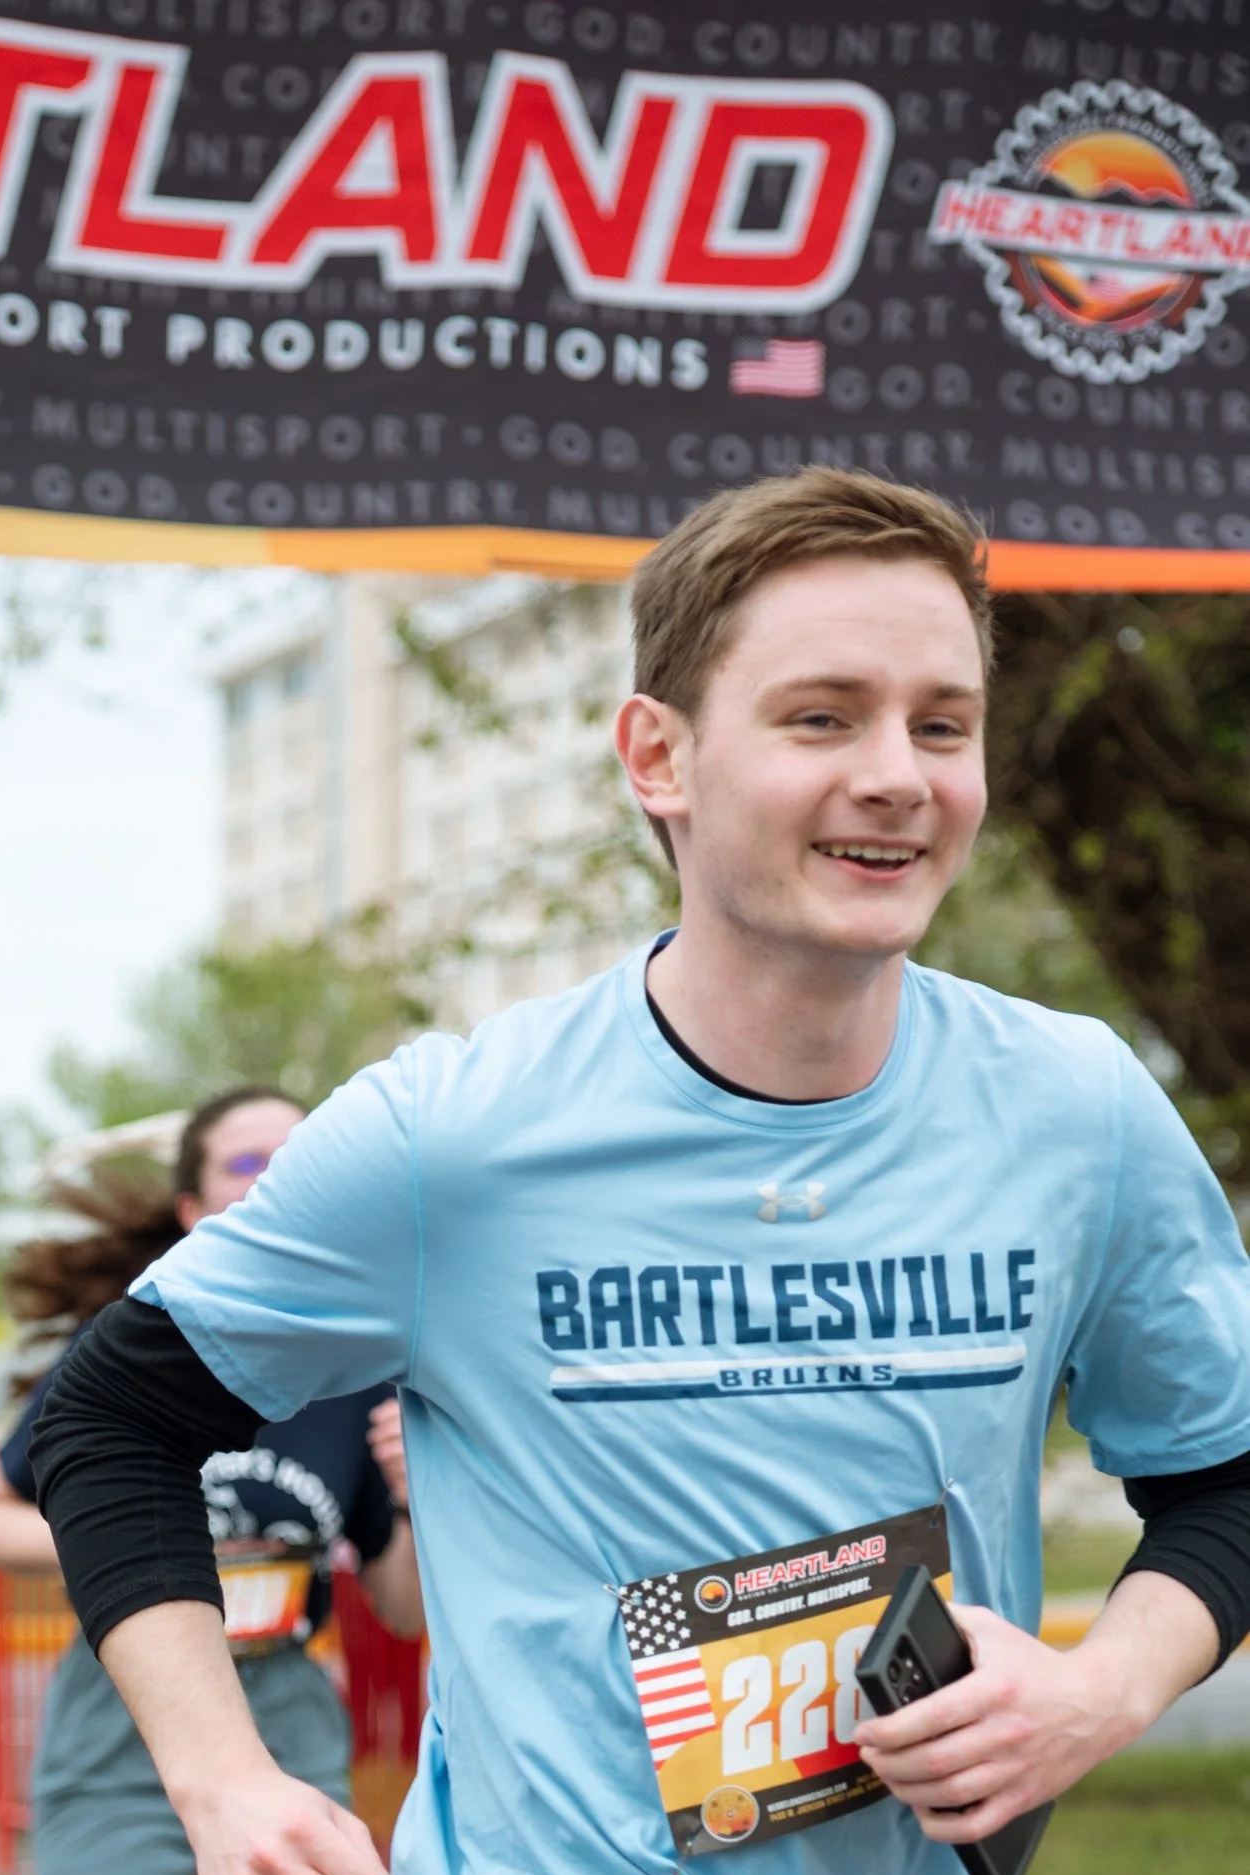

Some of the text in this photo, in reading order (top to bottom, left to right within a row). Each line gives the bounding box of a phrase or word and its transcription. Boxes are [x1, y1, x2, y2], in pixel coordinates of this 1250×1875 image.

[937, 183, 1250, 264] HEARTLAN
[166, 313, 709, 390] PRODUCTIONS
[31, 397, 448, 459] MULTISPORT
[536, 1248, 1036, 1350] BARTLESVILLE
[720, 1364, 893, 1388] BRUINS
[734, 1535, 887, 1595] HEARTLAND
